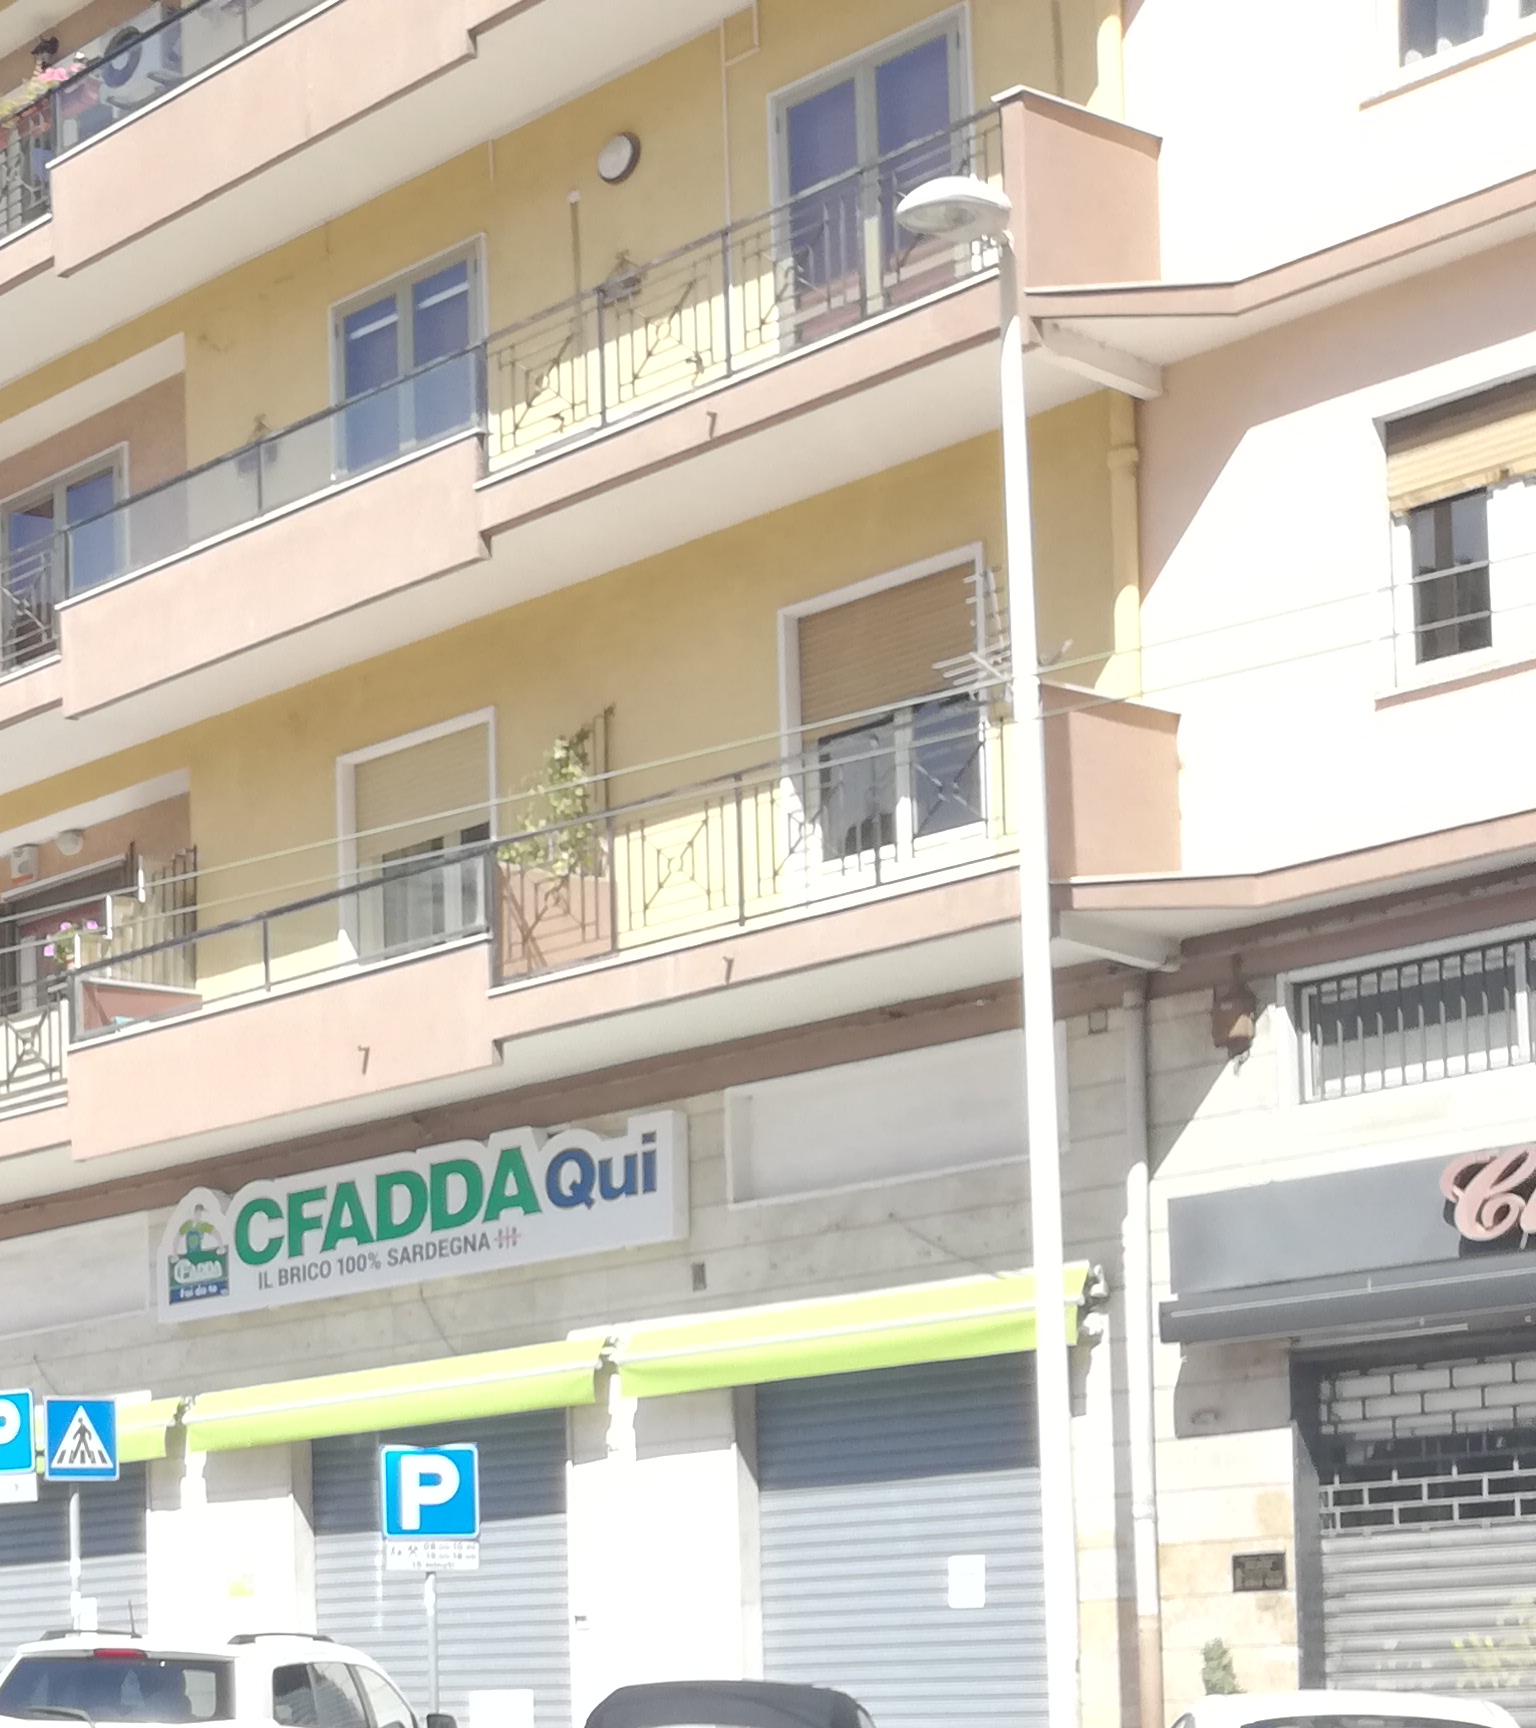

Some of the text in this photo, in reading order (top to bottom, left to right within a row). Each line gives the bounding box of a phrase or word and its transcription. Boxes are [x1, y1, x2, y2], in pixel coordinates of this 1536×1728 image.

[234, 1131, 658, 1267] CFADDA Qui
[258, 1232, 491, 1290] IL BRICO 100% SARDEGNA
[400, 1453, 461, 1531] P
